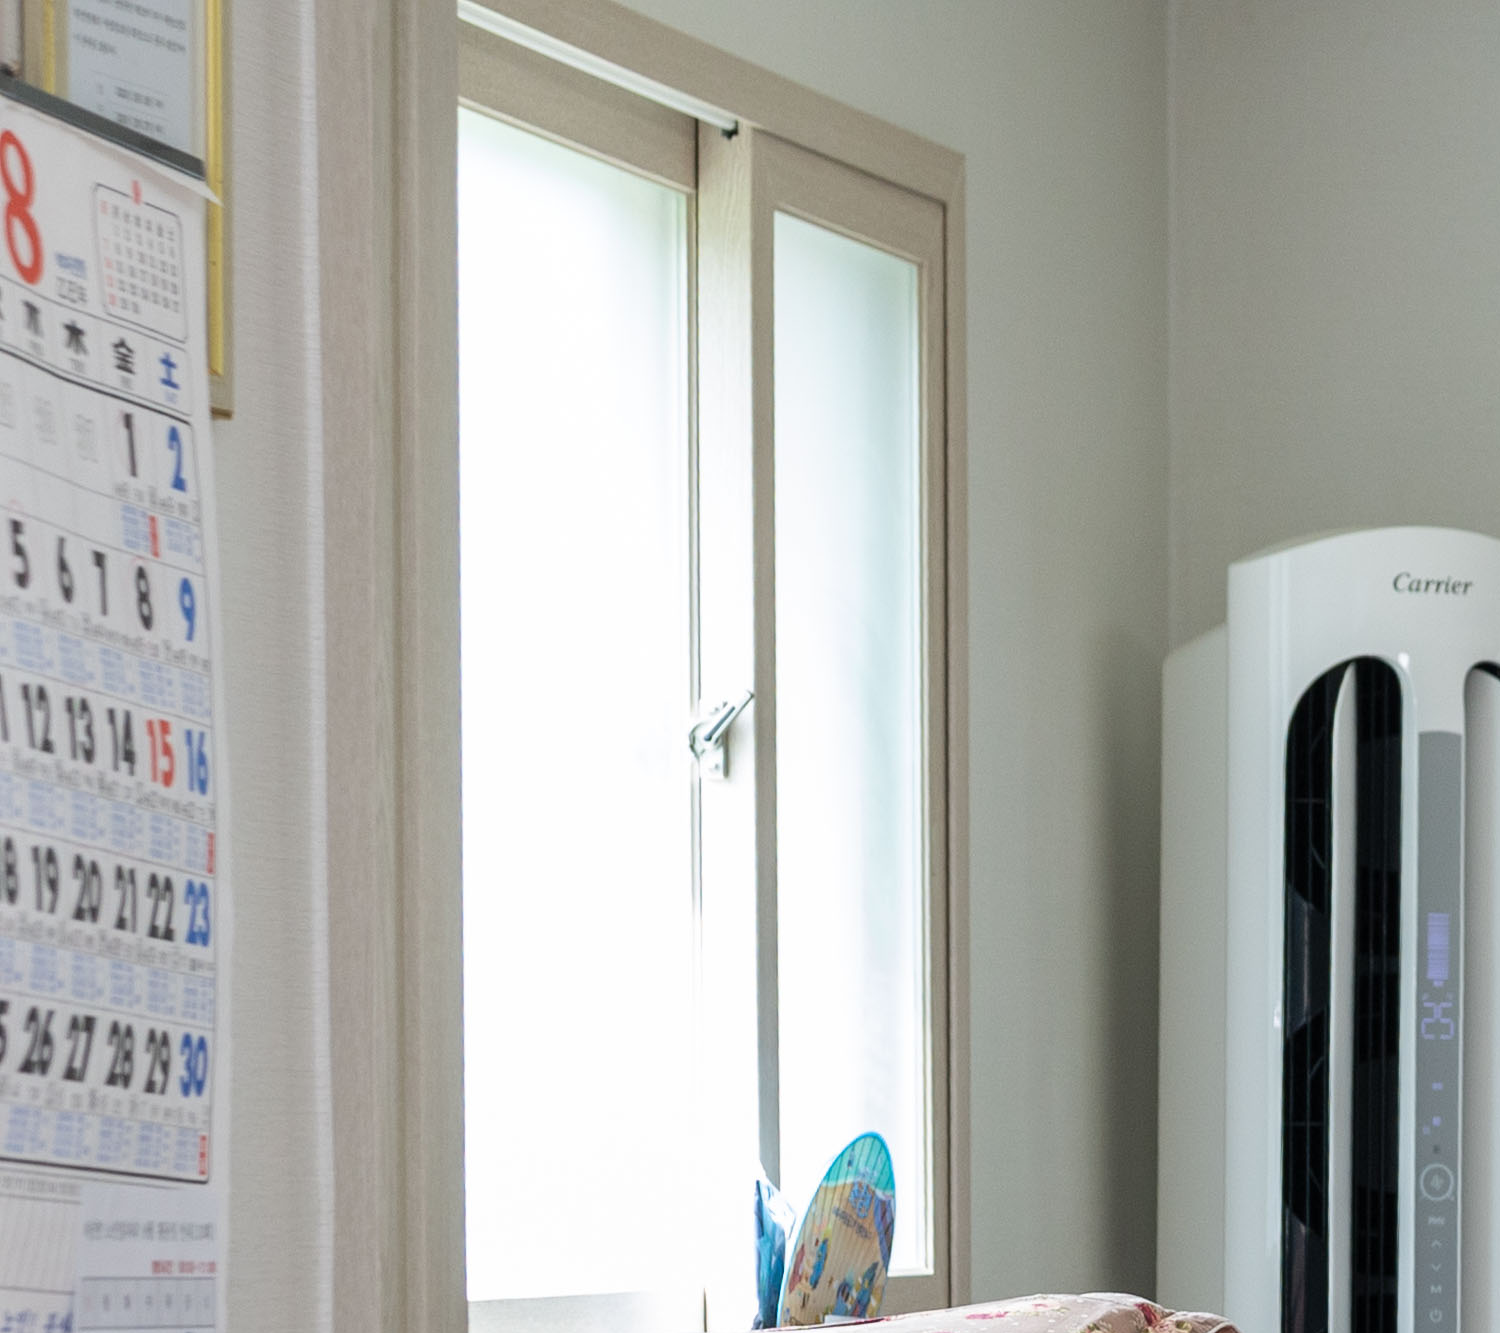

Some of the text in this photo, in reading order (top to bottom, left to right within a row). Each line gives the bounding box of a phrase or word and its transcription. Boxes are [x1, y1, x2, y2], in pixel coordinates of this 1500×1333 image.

[111, 336, 137, 376] 金
[158, 351, 181, 391] 土
[121, 411, 187, 492] 1 2
[9, 519, 198, 643] 5 6 7 8 9
[1392, 573, 1473, 595] Carrier
[21, 682, 55, 754] 12
[65, 696, 96, 764] 13
[106, 707, 137, 777] 14
[146, 719, 176, 788] 15
[185, 729, 210, 796] 16
[31, 845, 60, 914] 19
[71, 853, 104, 923] 20
[113, 863, 138, 933] 21
[146, 872, 176, 942] 22
[184, 878, 211, 947] 23
[17, 1005, 56, 1077] 26
[63, 1014, 98, 1084] 27
[105, 1020, 136, 1091] 28
[143, 1027, 173, 1098] 29
[179, 1032, 210, 1098] 30
